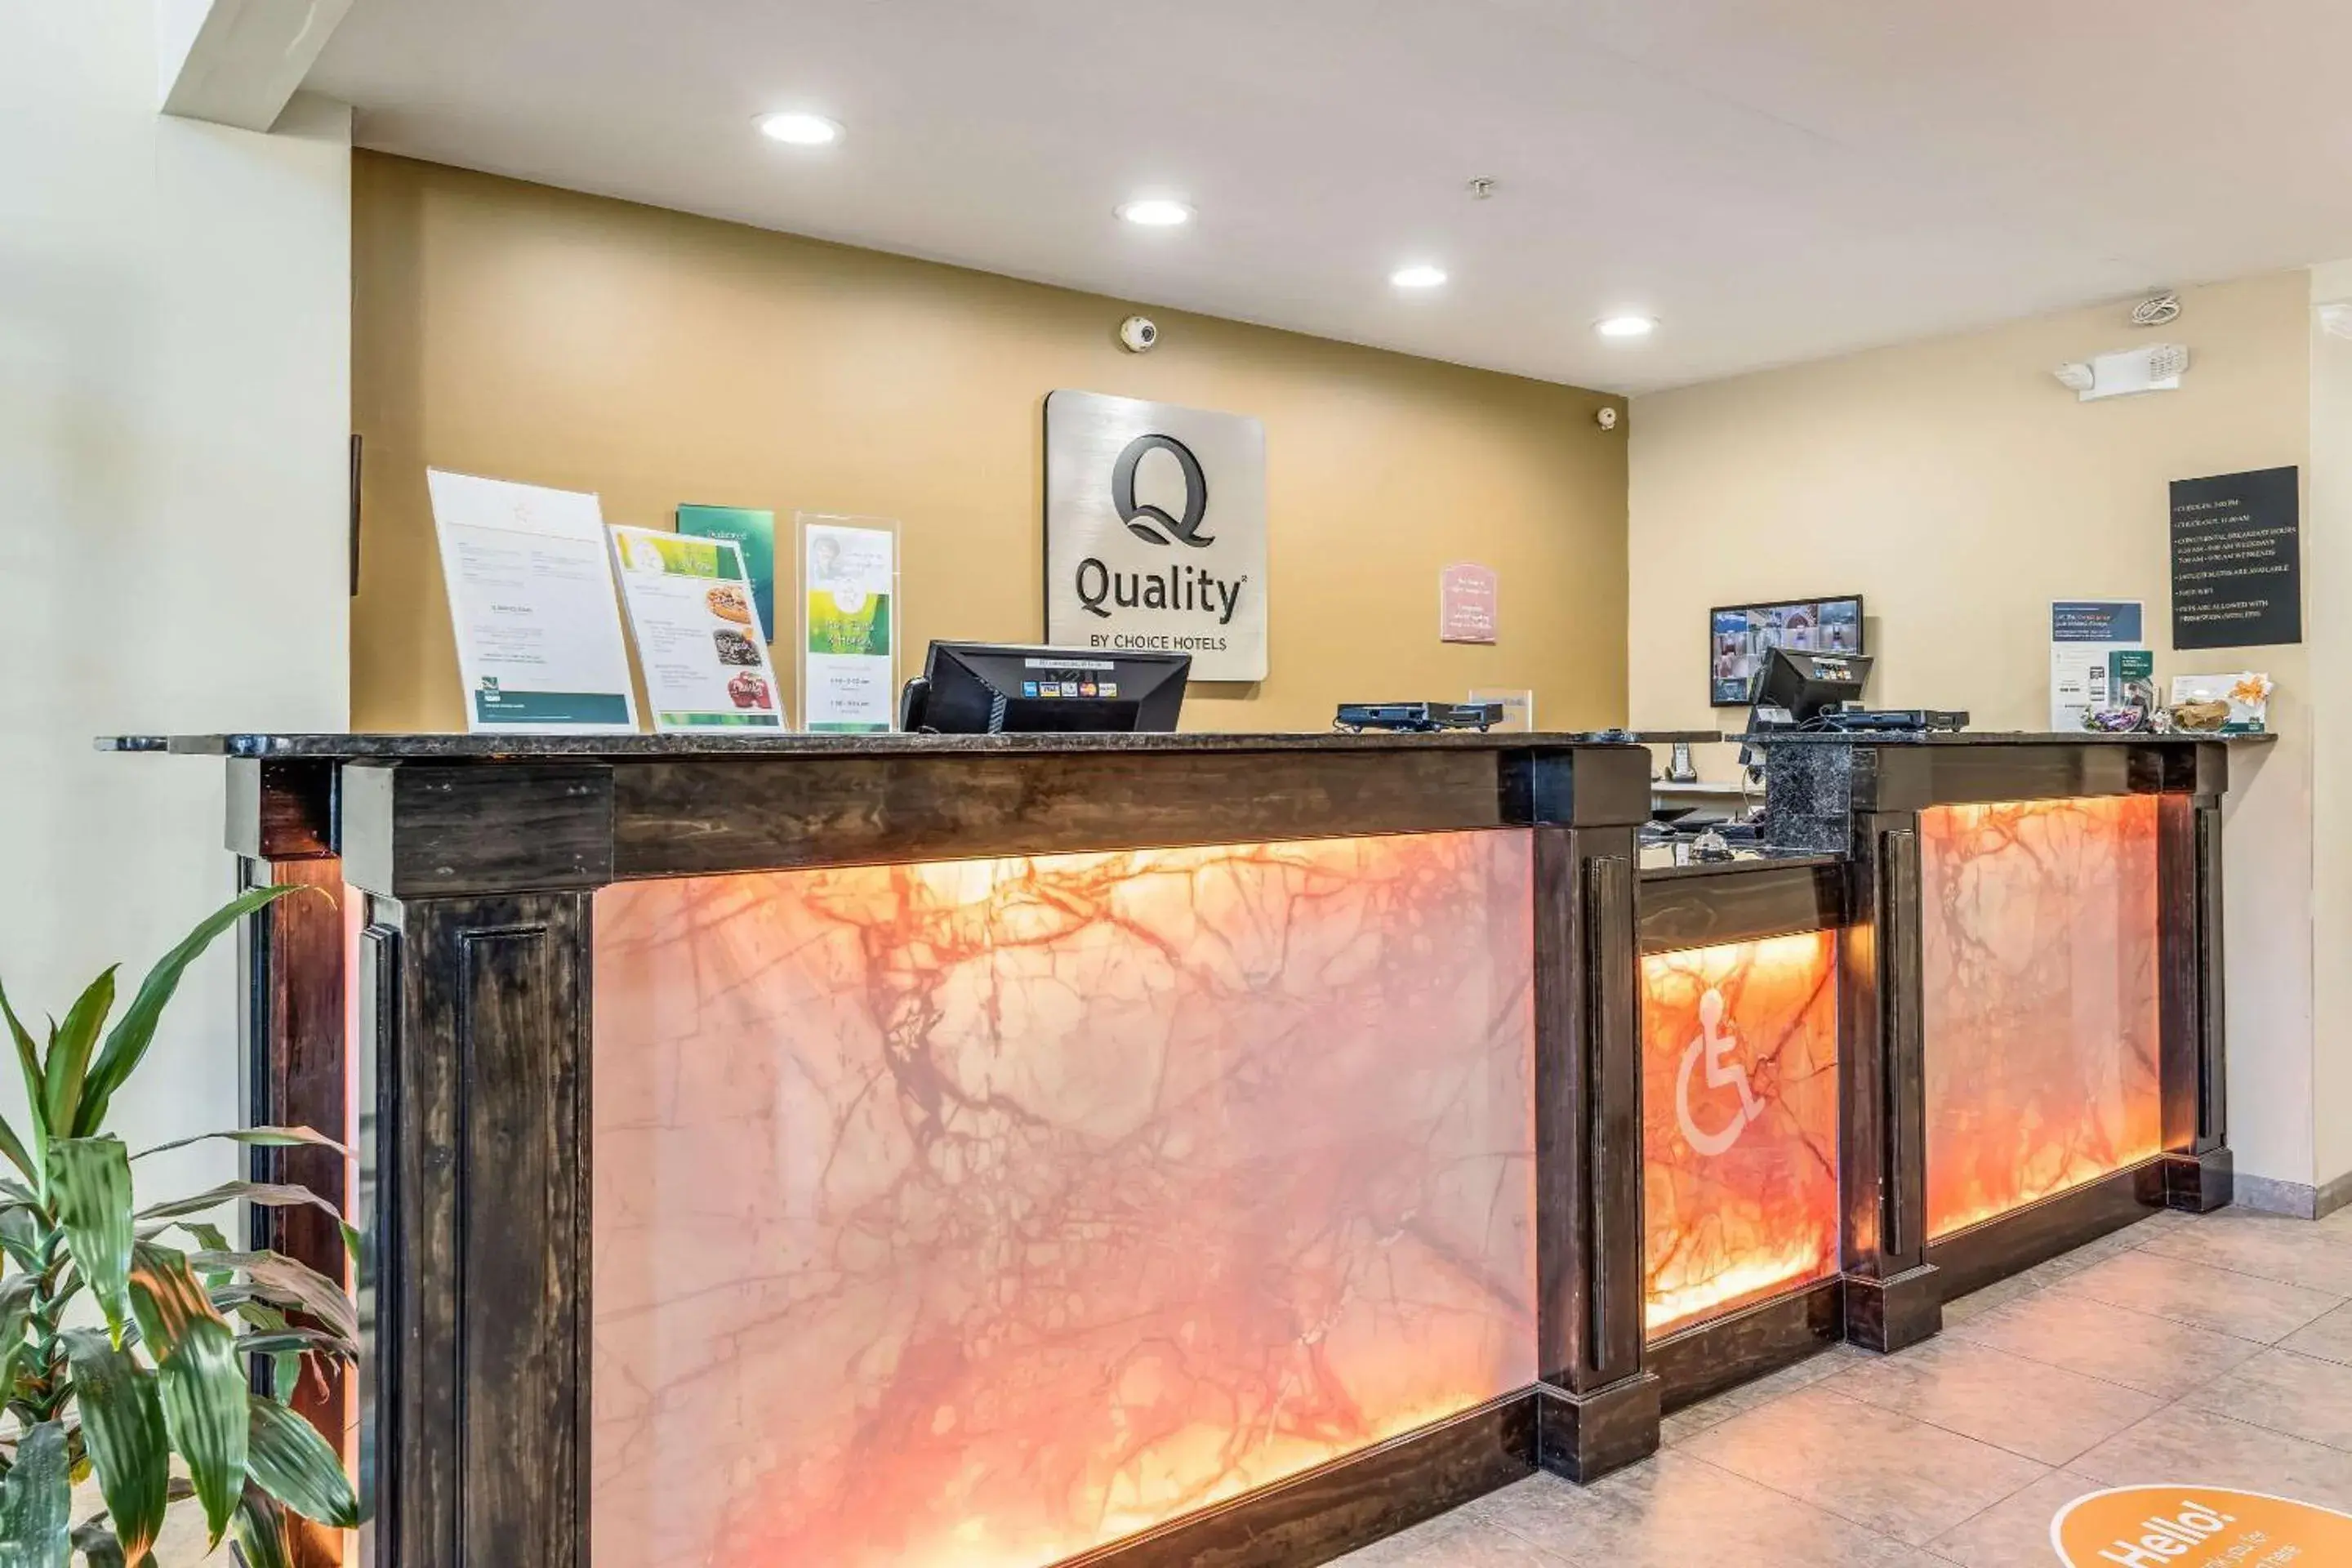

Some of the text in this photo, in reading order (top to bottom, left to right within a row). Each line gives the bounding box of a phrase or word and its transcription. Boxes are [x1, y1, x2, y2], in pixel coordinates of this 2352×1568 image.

[1111, 434, 1215, 548] Q
[1075, 557, 1242, 625] Quality
[2212, 601, 2247, 610] ALLOWED
[2248, 599, 2269, 608] WITH
[1090, 634, 1227, 651] BY CHOICE HOTELS
[2097, 1499, 2238, 1568] Hello!
